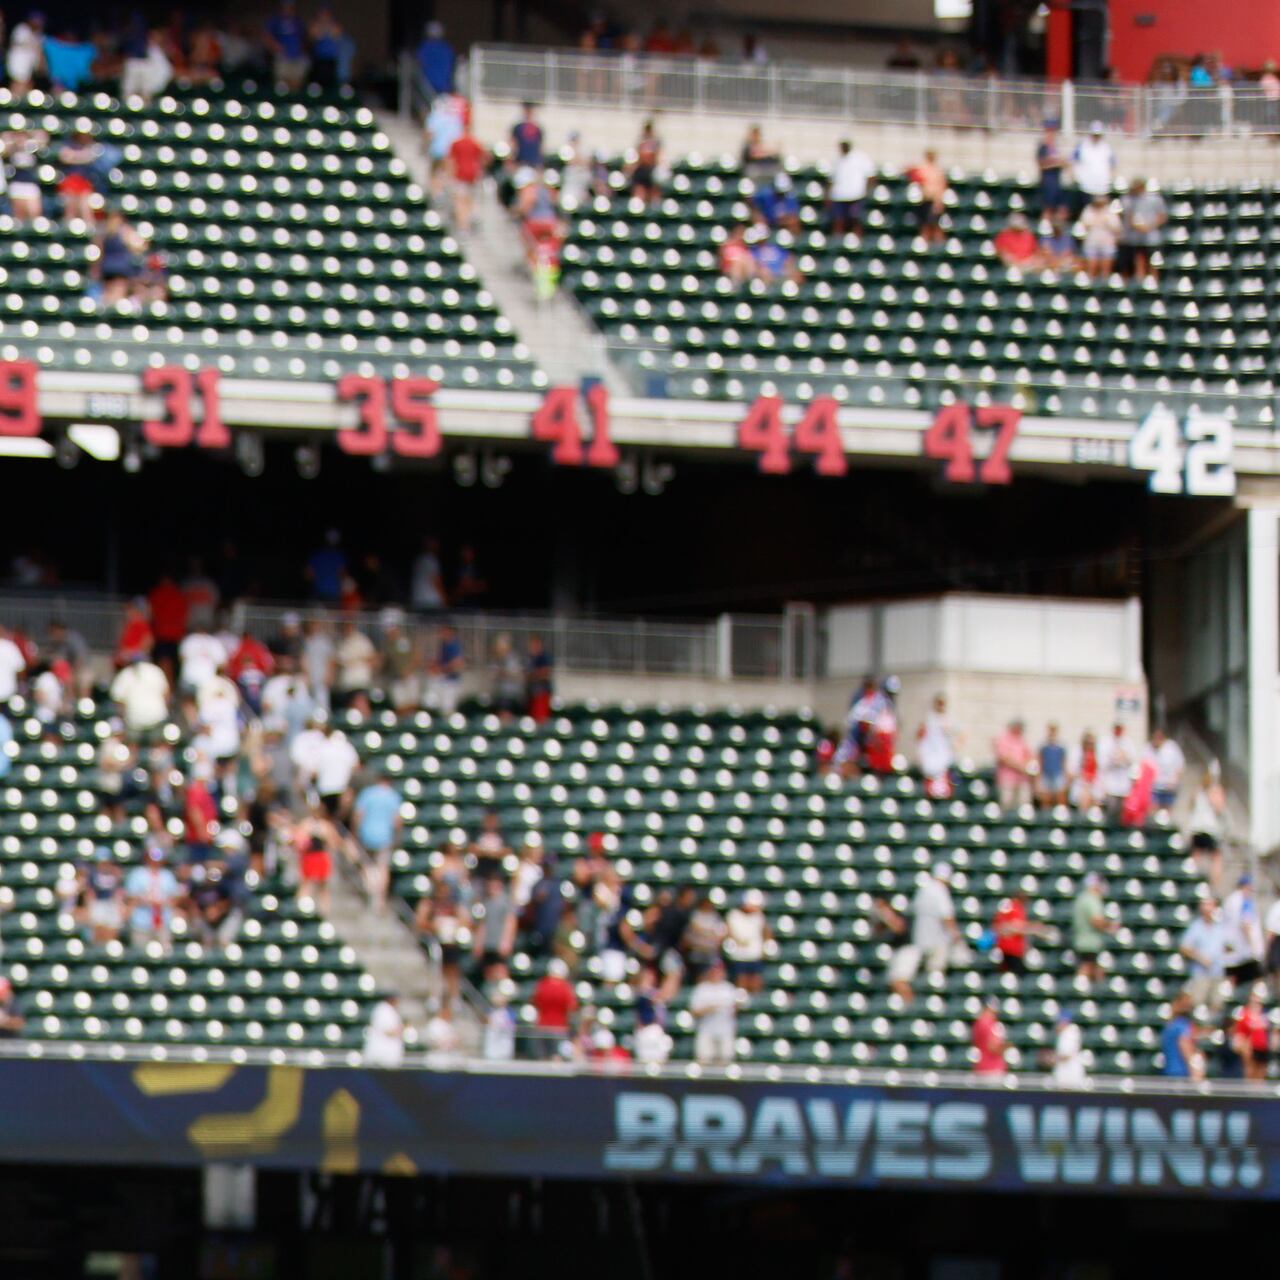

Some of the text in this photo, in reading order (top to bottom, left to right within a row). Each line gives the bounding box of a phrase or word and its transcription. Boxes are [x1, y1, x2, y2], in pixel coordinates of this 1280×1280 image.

[143, 366, 231, 448] 31
[337, 373, 441, 457] 35
[532, 384, 619, 467] 41
[738, 394, 847, 476] 44
[923, 402, 1023, 485] 47
[1130, 401, 1237, 496] 42
[605, 1092, 1262, 1189] BRAVES WIN!!
